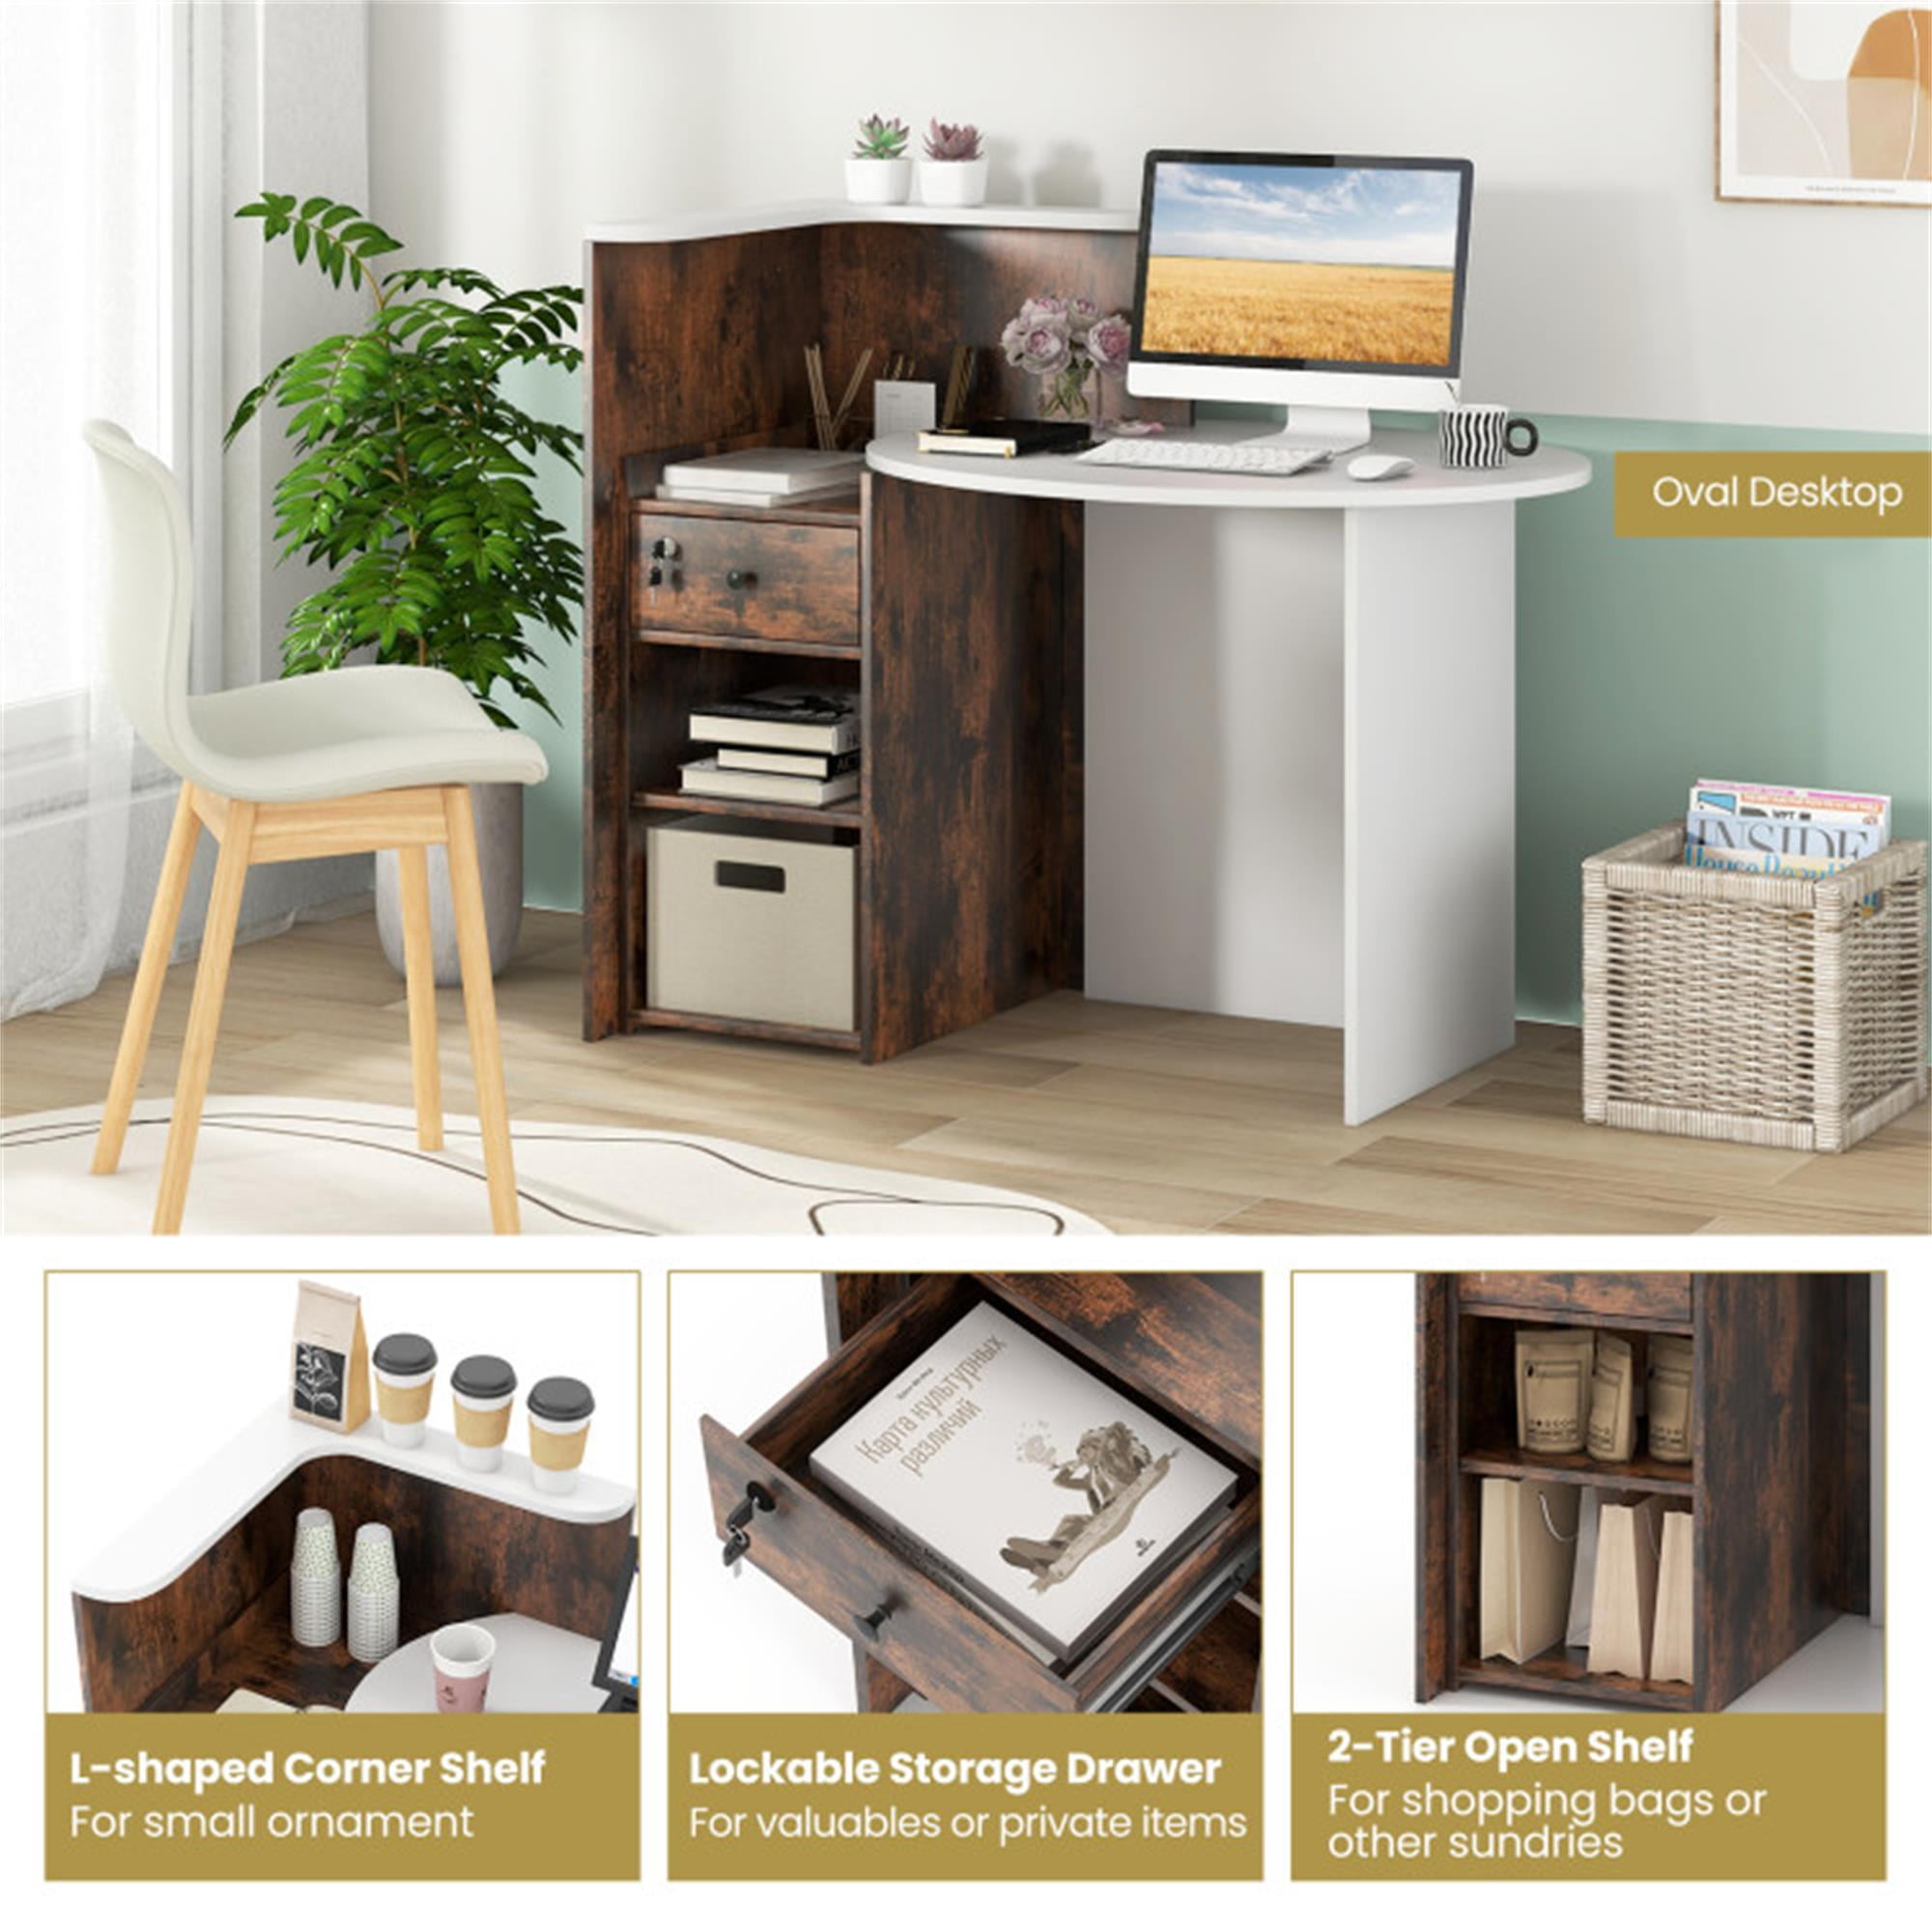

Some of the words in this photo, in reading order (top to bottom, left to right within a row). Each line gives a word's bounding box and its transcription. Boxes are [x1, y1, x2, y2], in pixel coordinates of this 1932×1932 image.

[855, 1416, 918, 1464] Карта
[909, 1335, 1008, 1422] культурных
[900, 1397, 982, 1478] различий
